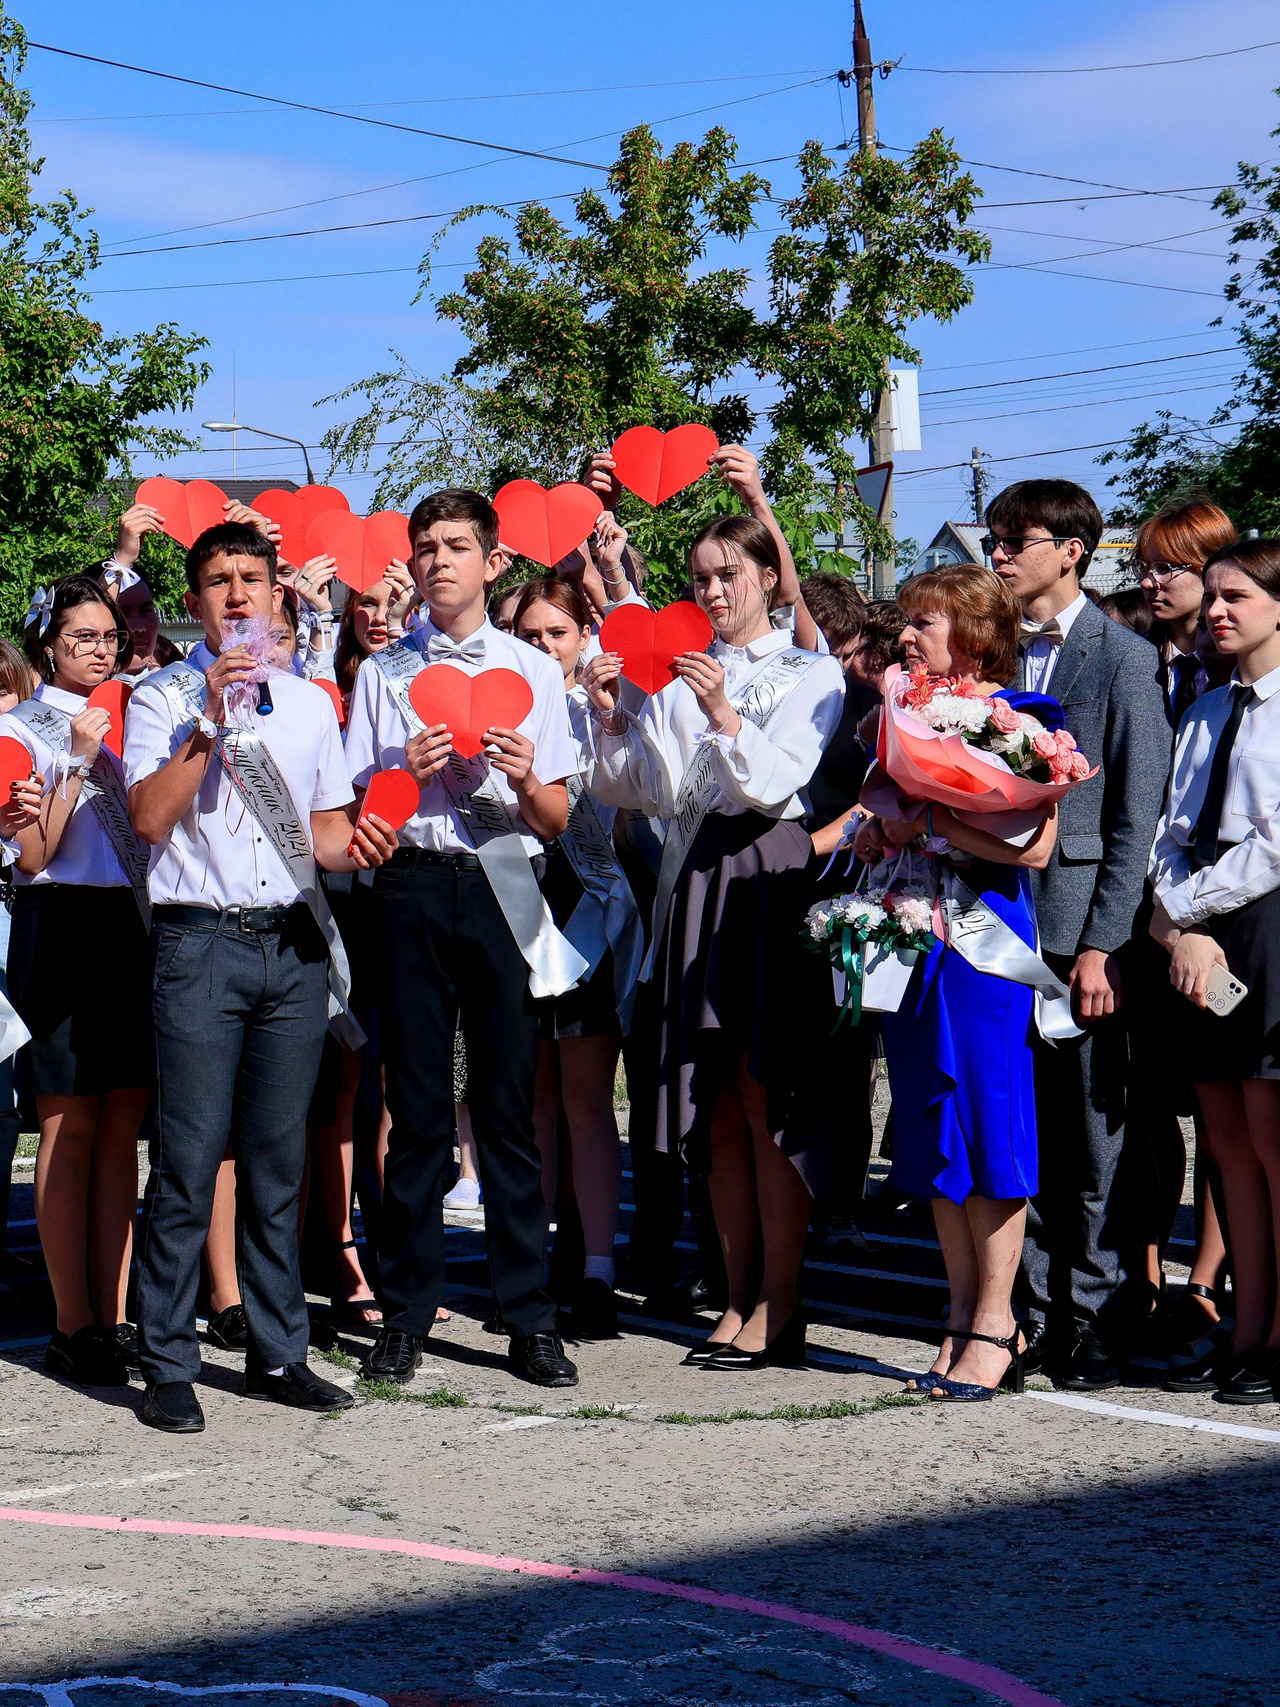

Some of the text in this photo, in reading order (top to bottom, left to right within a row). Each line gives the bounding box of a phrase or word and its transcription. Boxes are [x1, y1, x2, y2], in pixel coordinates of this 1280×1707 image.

[464, 791, 511, 834] 2024
[278, 820, 312, 861] 2024
[577, 842, 621, 880] 2024
